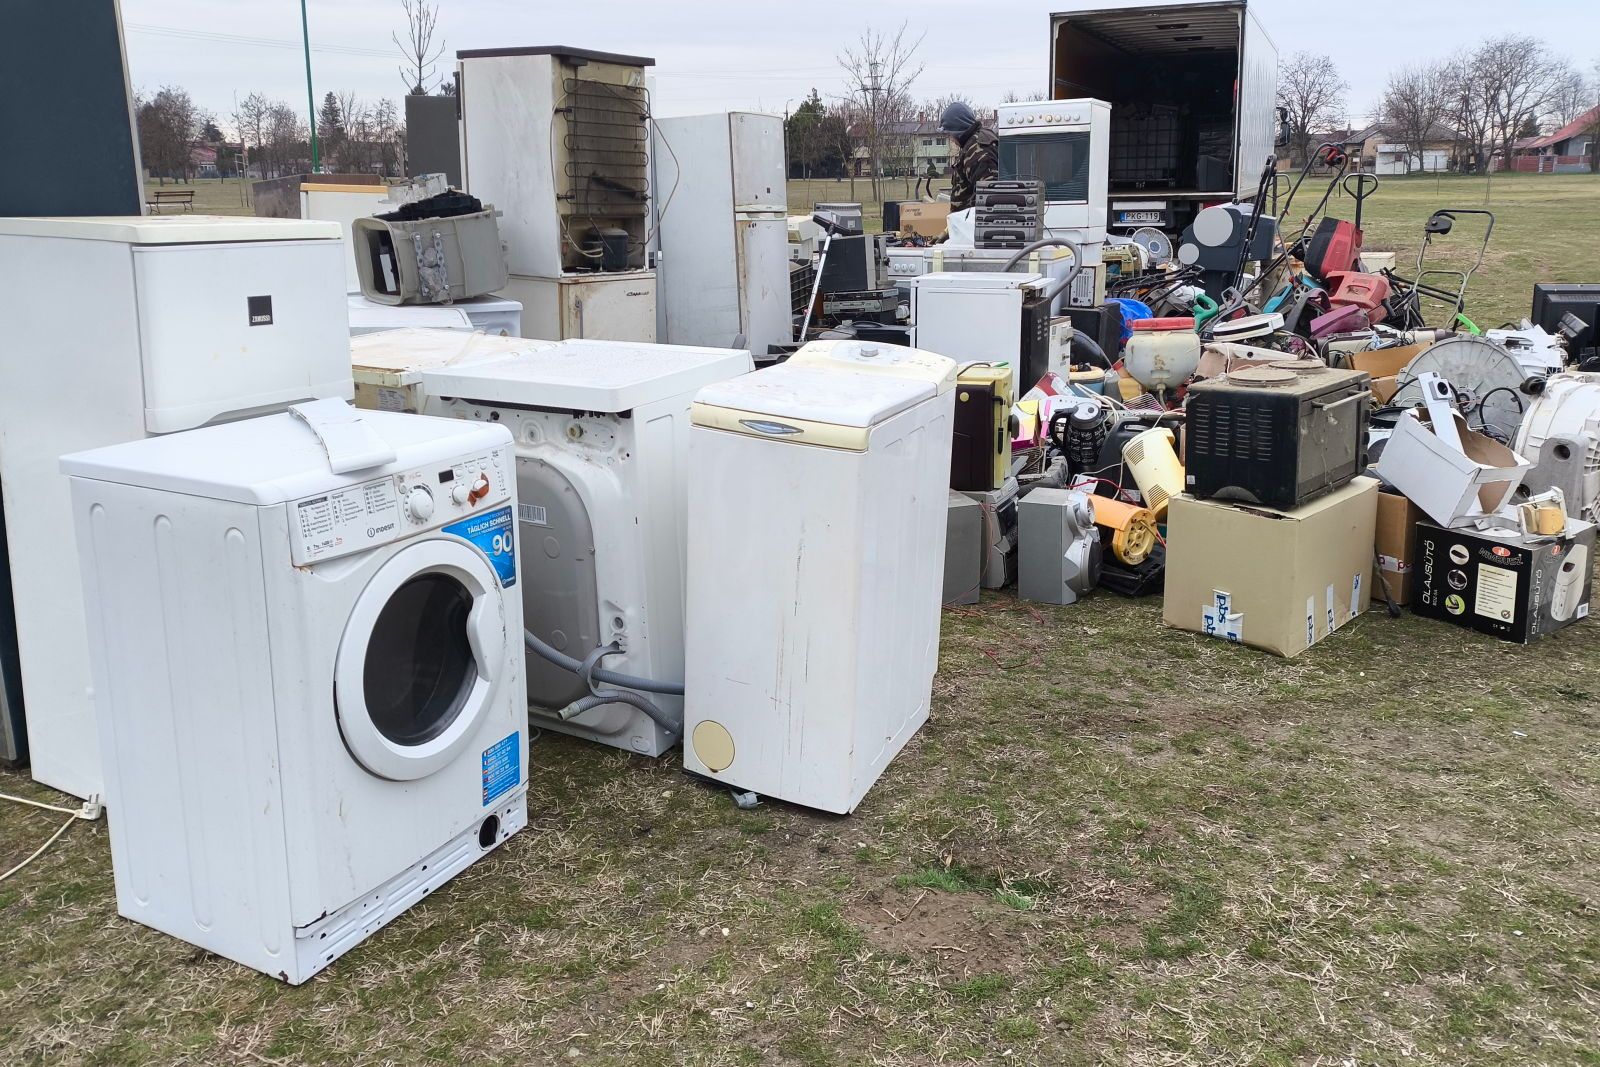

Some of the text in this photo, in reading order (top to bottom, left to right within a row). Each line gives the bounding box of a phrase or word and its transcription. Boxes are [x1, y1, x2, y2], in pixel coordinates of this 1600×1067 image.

[1125, 212, 1158, 220] PKG-119
[489, 514, 511, 527] SCHNELL
[492, 530, 513, 557] 90
[1216, 594, 1229, 624] pbs
